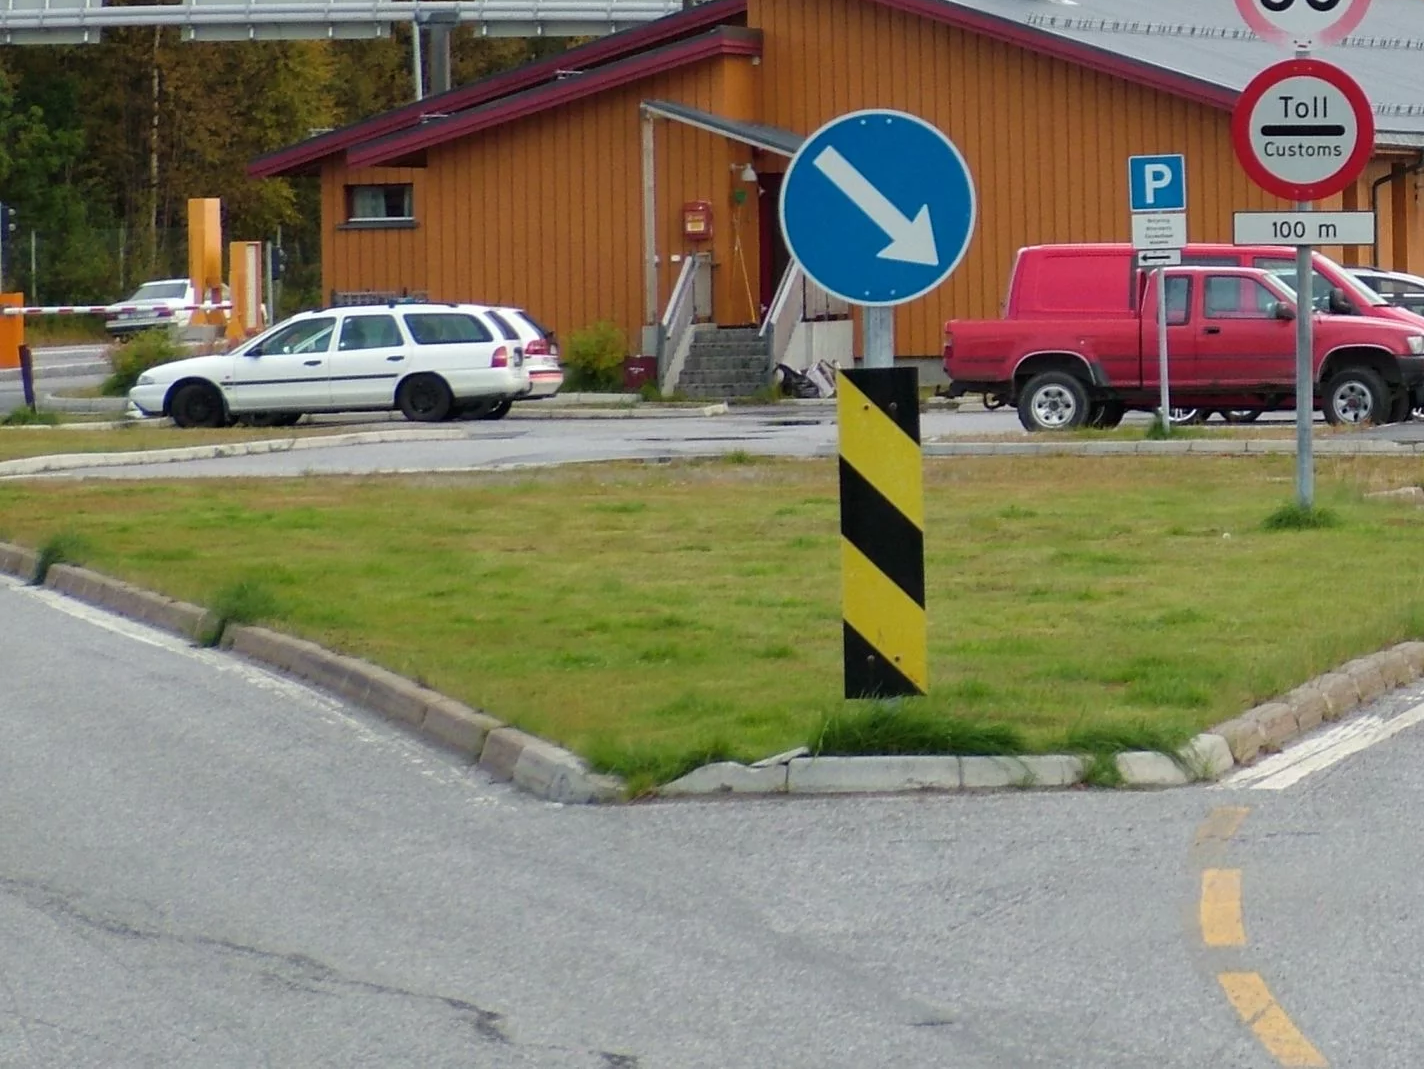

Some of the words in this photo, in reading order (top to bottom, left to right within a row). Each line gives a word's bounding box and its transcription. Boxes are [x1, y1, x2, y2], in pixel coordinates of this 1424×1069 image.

[1279, 96, 1328, 118] Toll
[1264, 141, 1343, 158] Customs
[1144, 164, 1172, 204] P
[1273, 220, 1305, 238] 100
[1319, 224, 1337, 238] m
